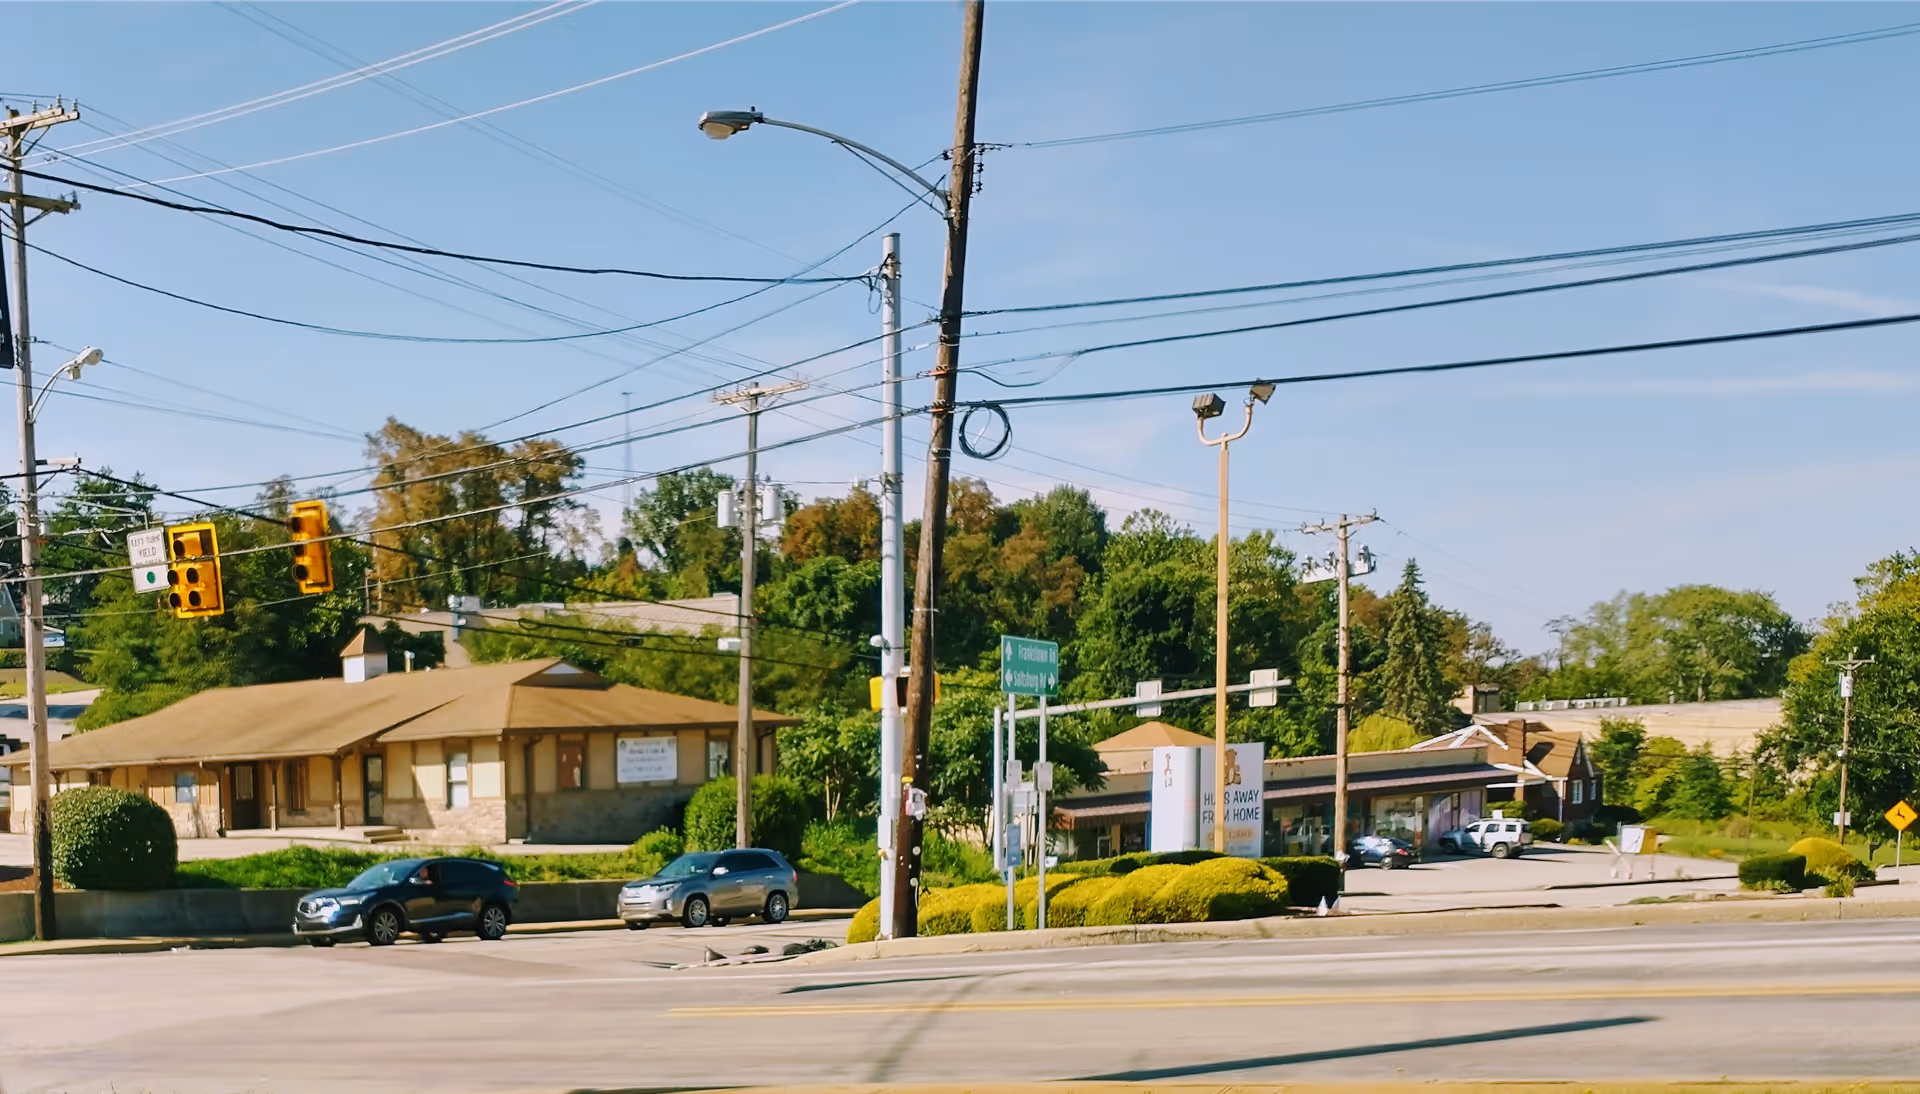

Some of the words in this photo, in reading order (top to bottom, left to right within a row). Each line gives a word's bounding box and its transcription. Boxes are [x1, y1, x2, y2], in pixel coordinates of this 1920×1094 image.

[131, 537, 144, 547] LEFT
[146, 534, 160, 543] TURN
[139, 547, 156, 557] YIELD
[1203, 791, 1230, 805] HUS
[1233, 789, 1259, 804] AWAY
[1203, 809, 1229, 824] FRM
[1233, 807, 1260, 821] HOME
